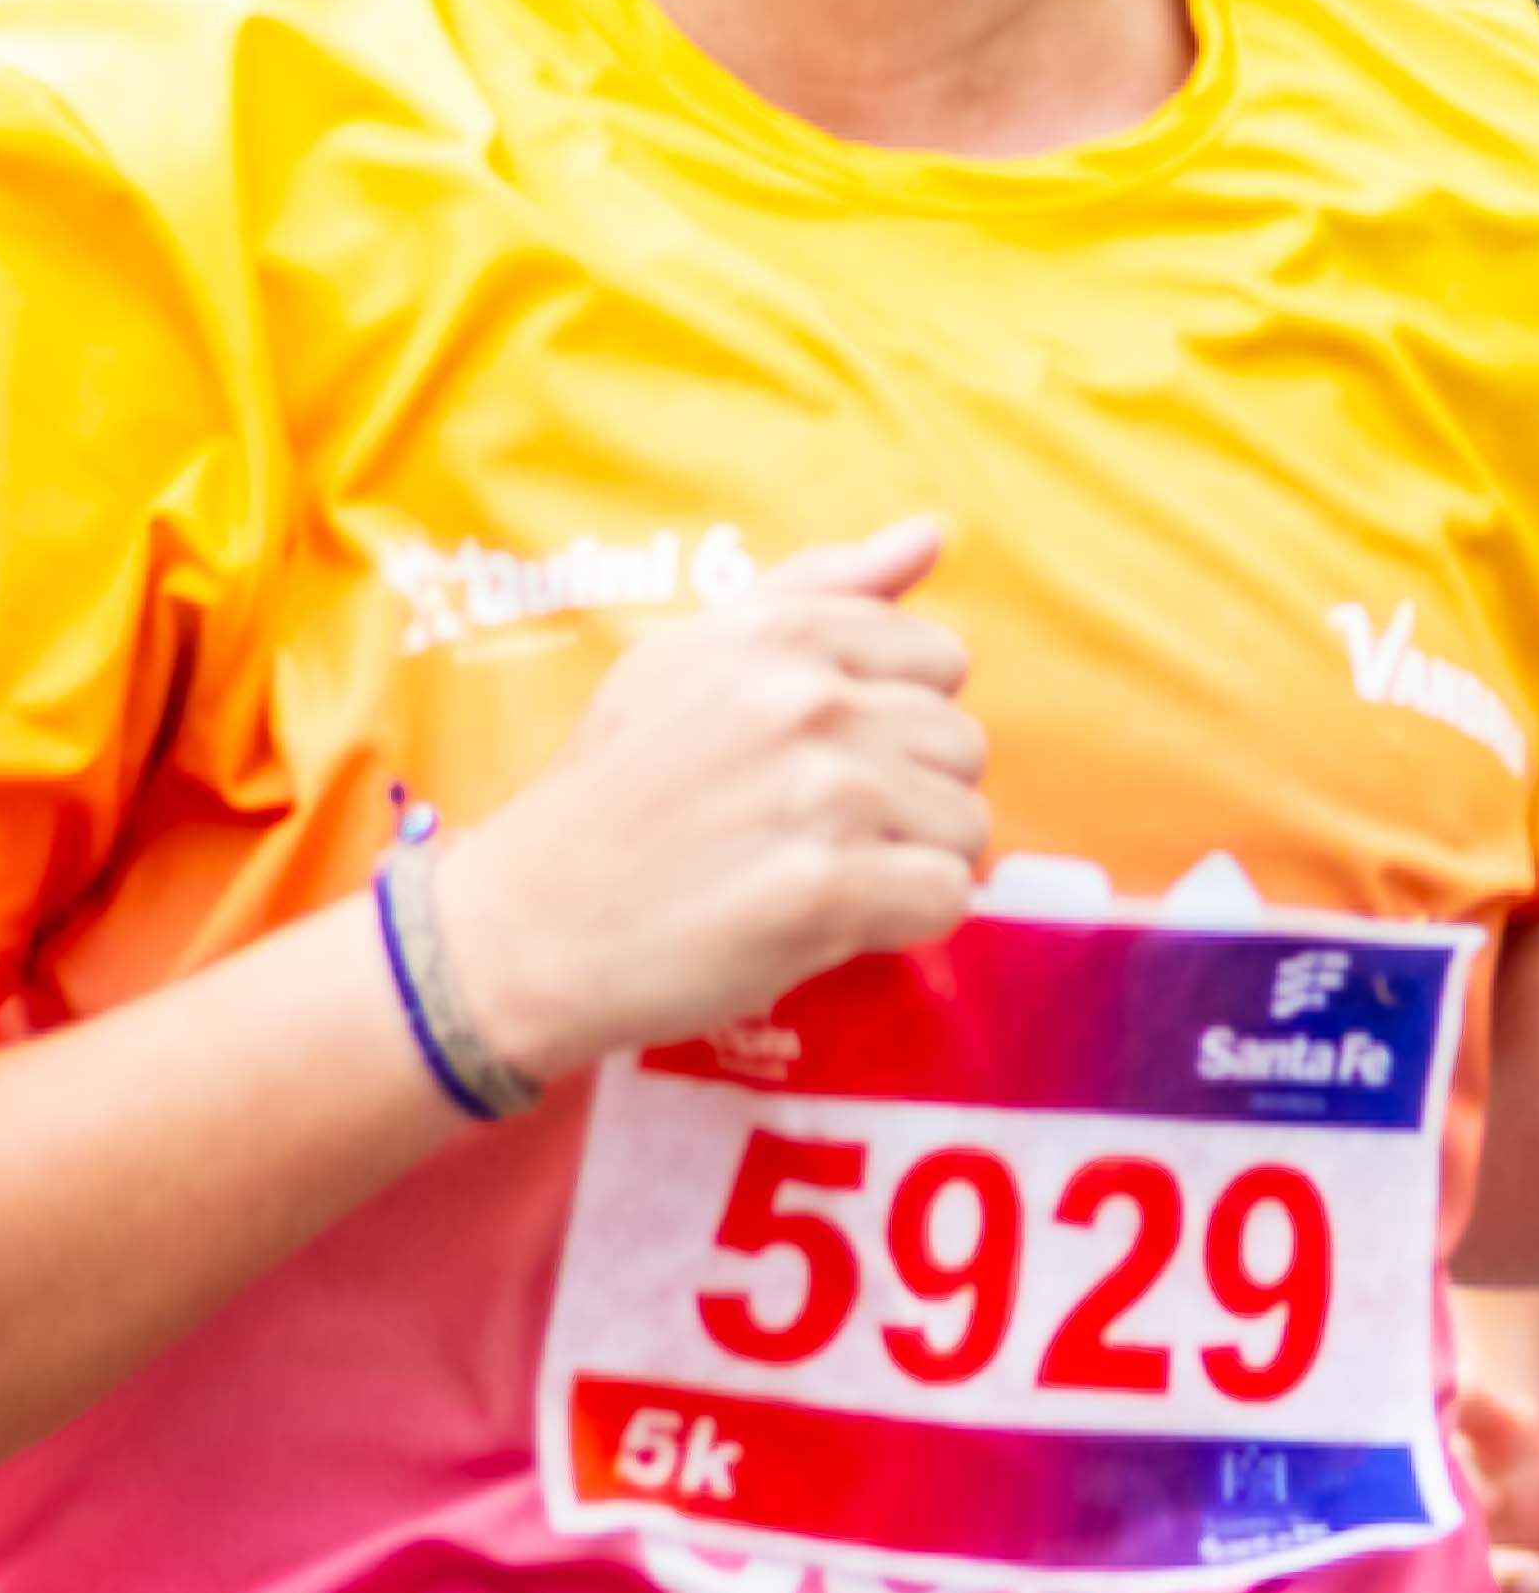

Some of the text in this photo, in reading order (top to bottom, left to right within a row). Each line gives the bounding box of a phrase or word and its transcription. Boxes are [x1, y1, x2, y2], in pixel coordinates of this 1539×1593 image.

[1197, 1023, 1393, 1090] Santa Fe
[695, 1127, 1334, 1403] 5929
[613, 1411, 745, 1501] 5k
